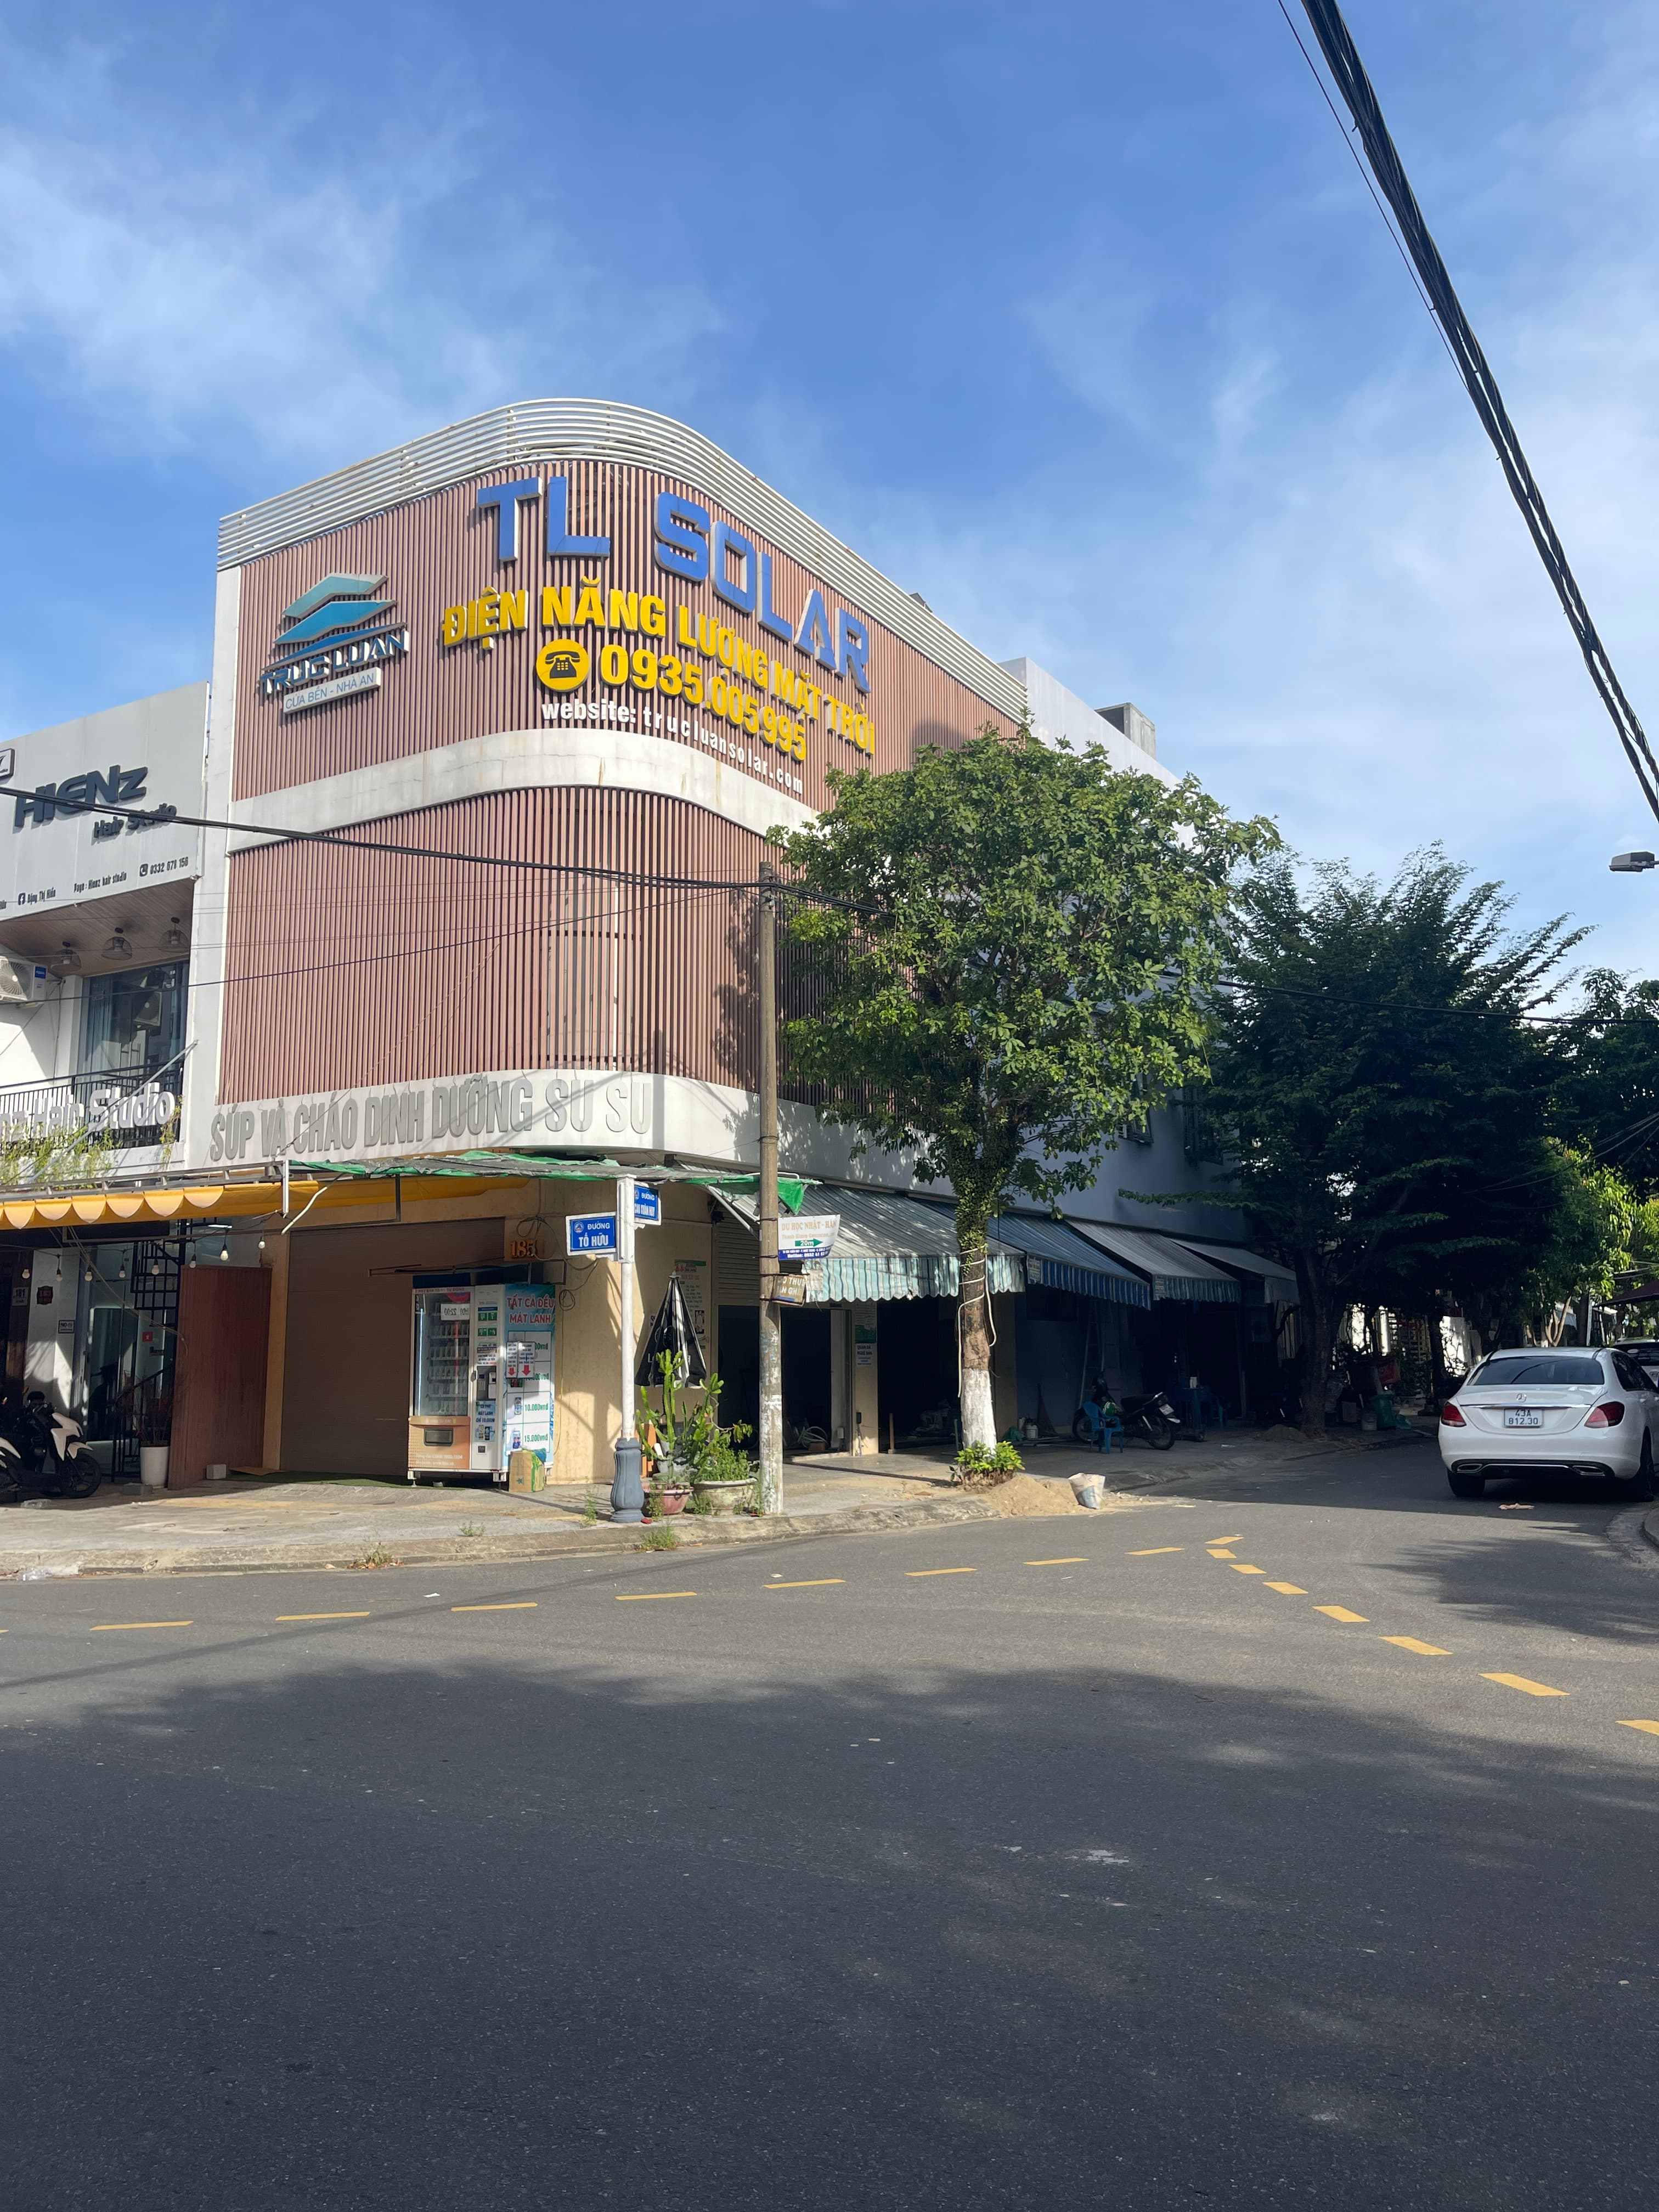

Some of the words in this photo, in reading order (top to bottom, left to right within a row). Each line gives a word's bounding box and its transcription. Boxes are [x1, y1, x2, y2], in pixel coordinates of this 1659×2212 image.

[477, 476, 610, 562] TL
[654, 491, 871, 693] SOLAR
[442, 586, 529, 650] ĐIỆN
[541, 575, 667, 639] NĂNG
[675, 605, 768, 690] LƯỢNG
[770, 660, 822, 722] MẶT
[823, 693, 874, 756] TRỜI
[285, 692, 306, 709] CỬA
[336, 675, 357, 694] NHÀ
[360, 673, 374, 687] AN
[541, 698, 636, 724] website:
[14, 765, 148, 827] HIENZ
[94, 816, 125, 838] Hair
[88, 1081, 176, 1132] Studio
[210, 1103, 255, 1162] SÚP
[261, 1097, 286, 1158] VÀ
[292, 1091, 358, 1154] CHÁO
[364, 1089, 425, 1148] DINH
[432, 1074, 534, 1139] DƯỠNG
[545, 1079, 594, 1132] SU
[606, 1081, 652, 1135] SU
[587, 1221, 611, 1230] ĐƯỜNG
[591, 1232, 608, 1247] HỮU
[506, 1293, 523, 1307] TẤT
[524, 1294, 536, 1308] CẢ
[510, 1311, 528, 1323] MÁT
[530, 1313, 551, 1325] LẠNH
[1515, 1409, 1532, 1417] 43A
